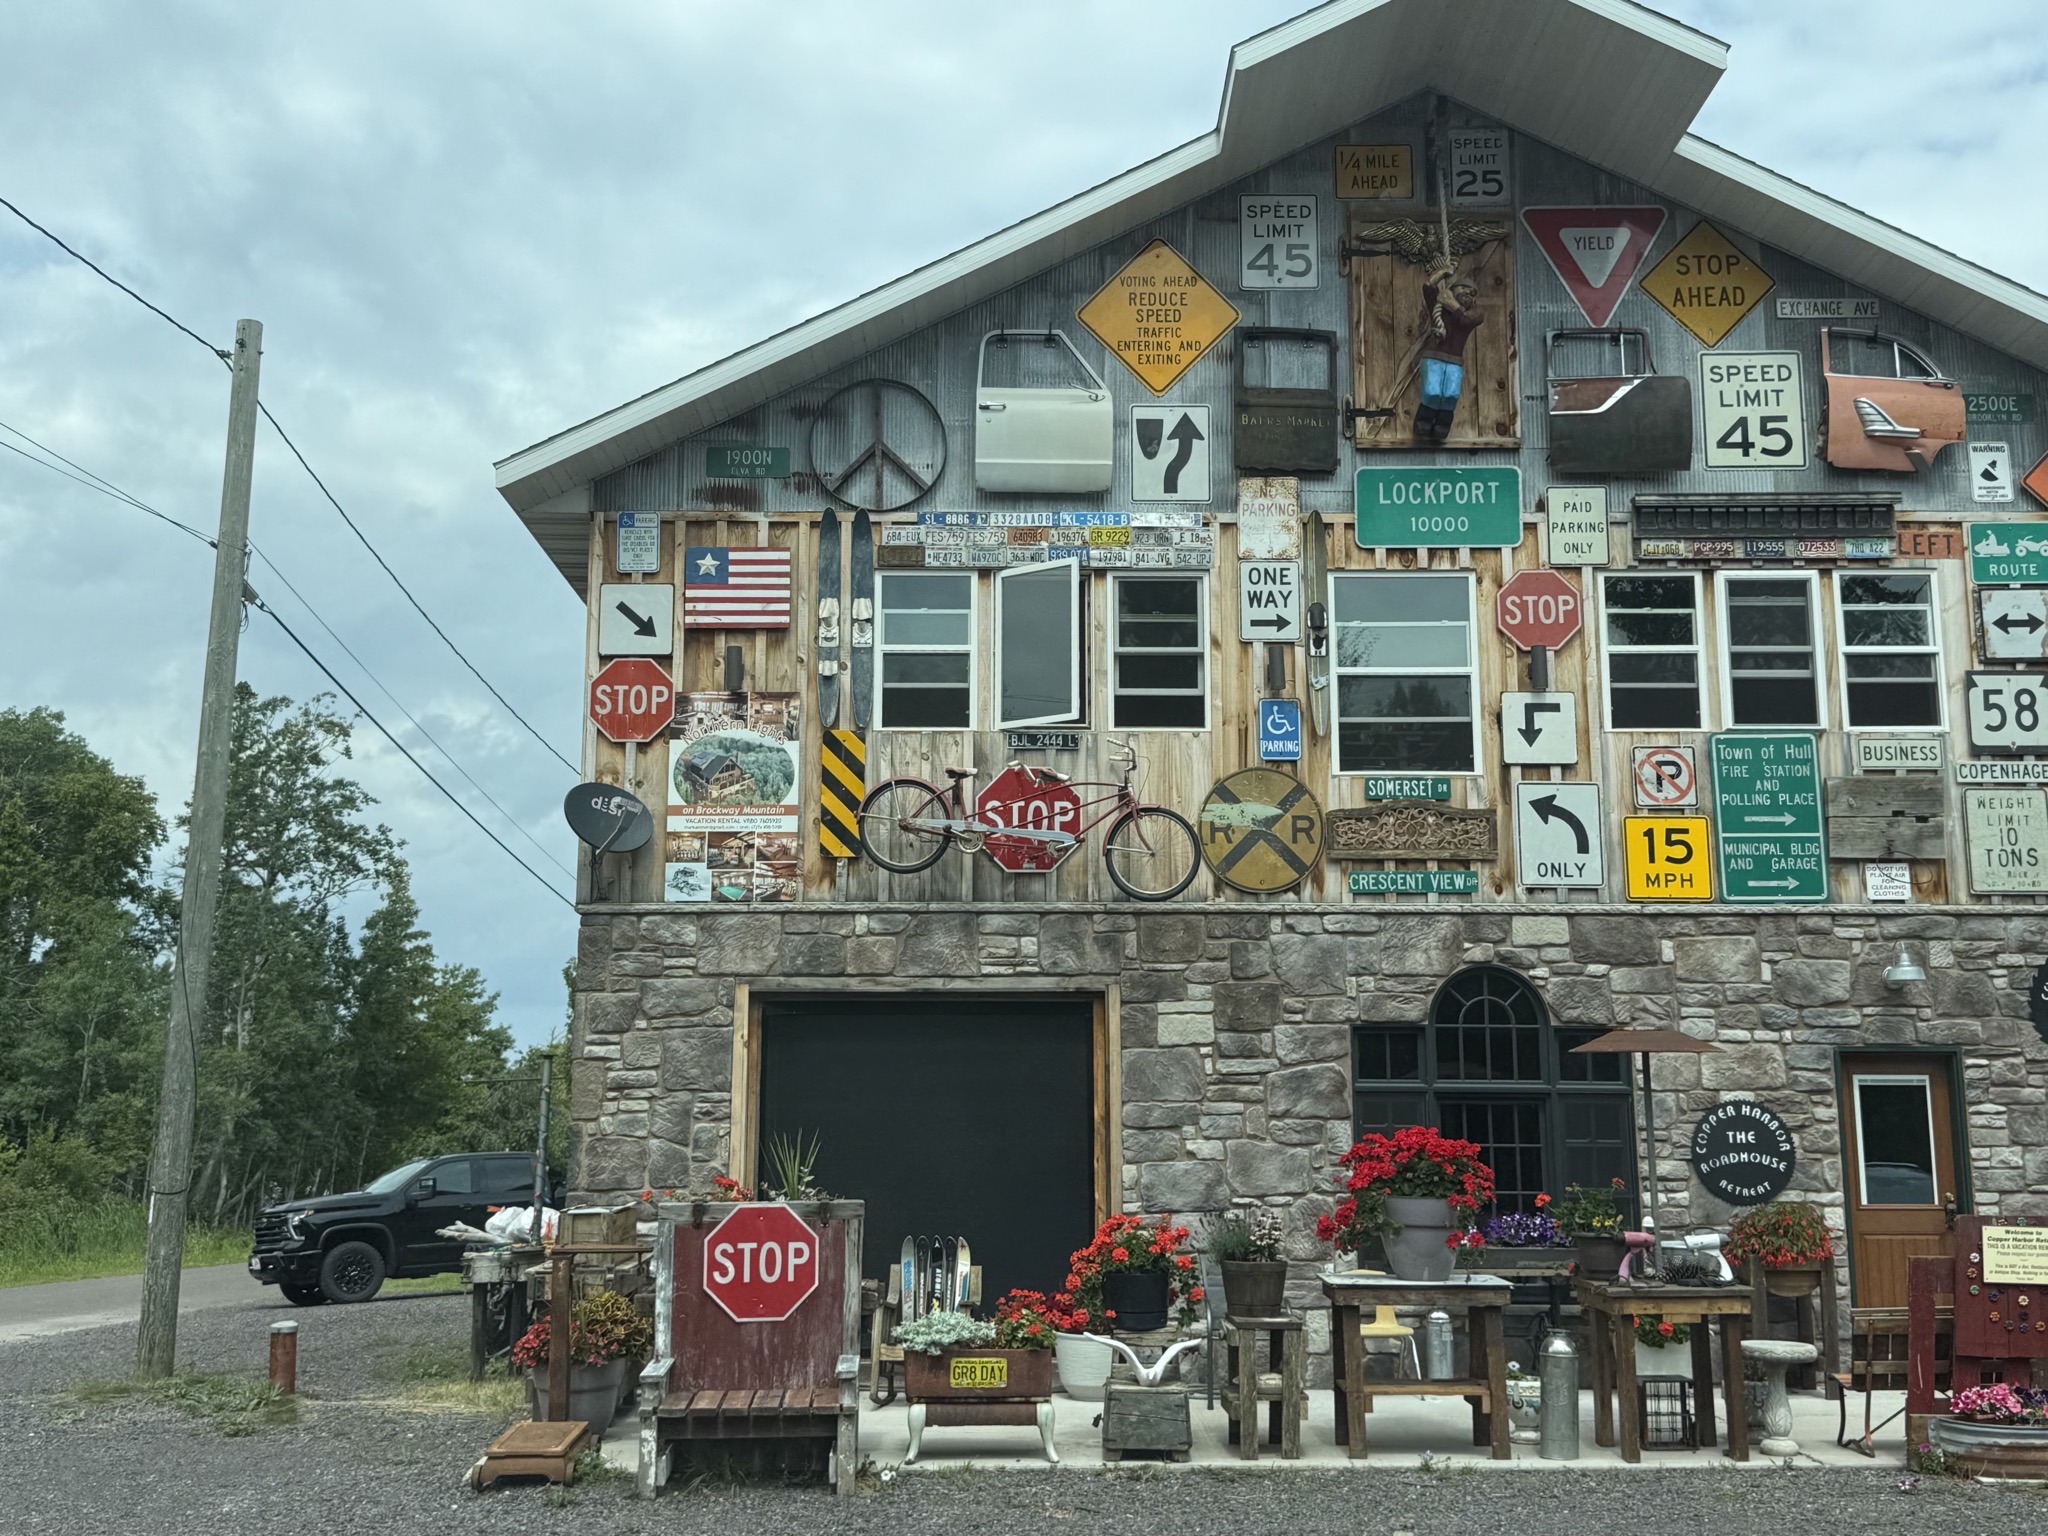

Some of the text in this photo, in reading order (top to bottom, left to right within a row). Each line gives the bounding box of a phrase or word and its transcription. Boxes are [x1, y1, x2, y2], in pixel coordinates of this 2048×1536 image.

[1454, 138, 1503, 150] SPEED
[1366, 154, 1400, 169] MILE
[1459, 154, 1498, 166] LIMIT
[1351, 175, 1399, 190] AHEAD
[1456, 170, 1505, 198] 25
[1246, 205, 1312, 219] SPEED
[1254, 224, 1305, 239] LIMIT
[1574, 236, 1615, 251] YIELD
[1246, 243, 1313, 278] 45
[1675, 255, 1741, 276] STOP
[1119, 276, 1198, 288] VOTING AHEAD
[1129, 292, 1188, 307] REDUCE
[1673, 286, 1746, 309] AHEAD
[1136, 309, 1182, 323] SPEED
[1780, 302, 1879, 317] EXCHANGE AVE
[1137, 327, 1182, 339] TRAFFIC
[1117, 340, 1202, 352] ENTERING AND
[1137, 354, 1182, 365] EXITING
[1709, 365, 1792, 383] SPEED
[1719, 389, 1784, 408] LIMIT
[1968, 396, 2018, 412] 2500E
[1716, 415, 1794, 458] 45
[1971, 445, 2006, 454] WARNING
[727, 450, 772, 466] 1900N
[756, 467, 766, 476] RD
[1378, 481, 1500, 505] LOCKPORT
[1242, 503, 1297, 518] PARKING
[1563, 501, 1592, 513] PAID
[1411, 516, 1469, 533] 10000
[1552, 522, 1605, 534] PARKING
[1563, 542, 1594, 554] ONLY
[1898, 534, 1954, 556] LEFT
[1249, 567, 1292, 586] ONE
[1989, 563, 2039, 577] ROUTE
[1247, 590, 1293, 609] WAY
[1504, 595, 1575, 626] STOP
[594, 684, 669, 716] STOP
[1982, 687, 2040, 733] 58
[680, 718, 789, 747] Northern Lights
[1262, 740, 1299, 753] PARKING
[1717, 744, 1812, 760] Town of Hull
[1863, 745, 1938, 762] BUSINESS
[1722, 765, 1811, 778] FIRE STATION
[1368, 779, 1448, 798] SOMERSET DR
[1755, 779, 1780, 792] AND
[591, 796, 624, 817] dis
[1721, 793, 1816, 806] POLLING PLACE
[1977, 797, 2034, 811] WEIGHT
[682, 805, 785, 816] on Brockway Mountain
[984, 799, 1076, 841] STOP
[1986, 815, 2030, 827] LIMIT
[1291, 815, 1317, 844] R
[1642, 827, 1694, 865] 15
[2000, 828, 2019, 848] 10
[1724, 842, 1820, 855] MUNICIPAL BLDG
[1729, 857, 1818, 870] AND GARAGE
[1984, 848, 2039, 868] TONS
[1537, 862, 1586, 878] ONLY
[1350, 874, 1424, 891] CRESCENT
[1430, 873, 1466, 891] VIEW
[1645, 873, 1694, 888] MPH
[1695, 1103, 1791, 1154] COPPER HARBOR
[1726, 1130, 1757, 1144] THE
[1700, 1152, 1788, 1175] ROADHOUSE
[1718, 1179, 1772, 1197] RETREAT
[712, 1241, 810, 1284] STOP
[934, 1268, 942, 1297] ATOMIC
[953, 1365, 1005, 1381] GR8 DAY
